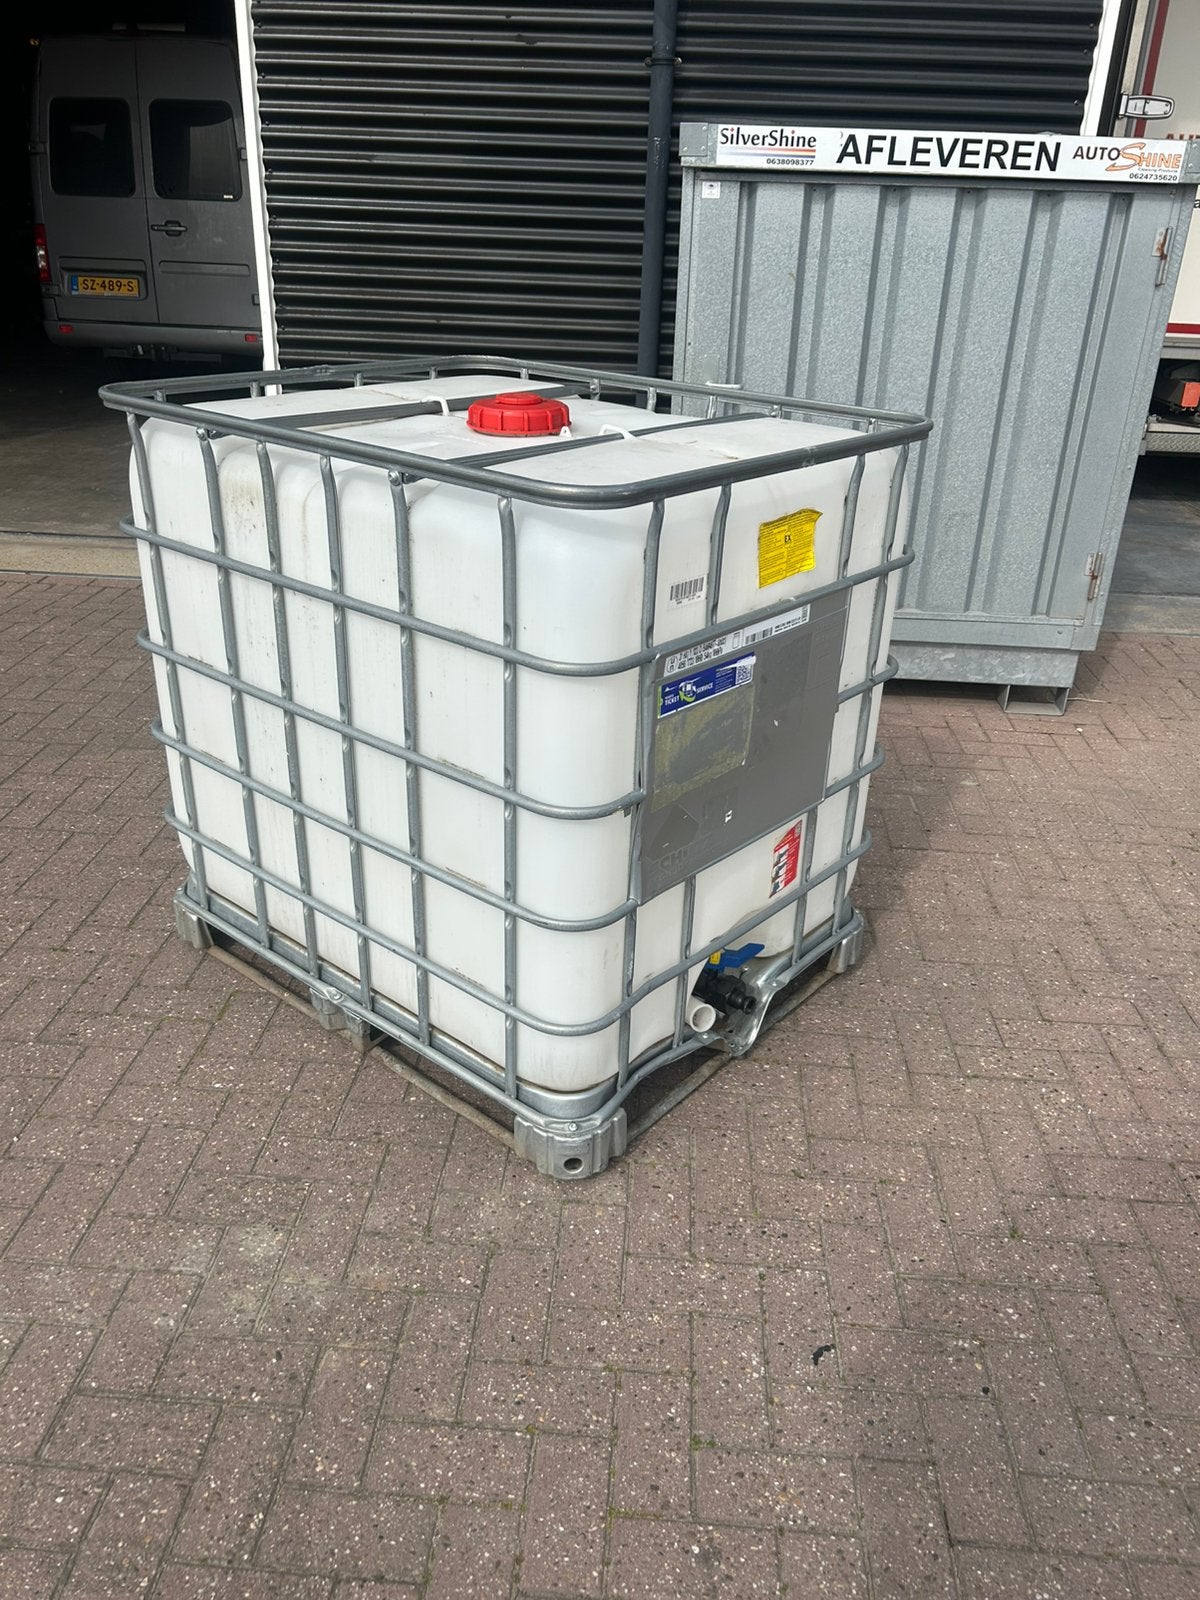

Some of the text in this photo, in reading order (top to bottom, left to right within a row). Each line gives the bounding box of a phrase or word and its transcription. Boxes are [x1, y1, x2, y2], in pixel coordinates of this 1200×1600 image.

[720, 127, 817, 148] SilverShine
[836, 134, 1061, 172] AFLEVEREN
[766, 158, 815, 166] 0638098377
[1129, 172, 1178, 181] 0624735620
[664, 694, 680, 706] TICKET
